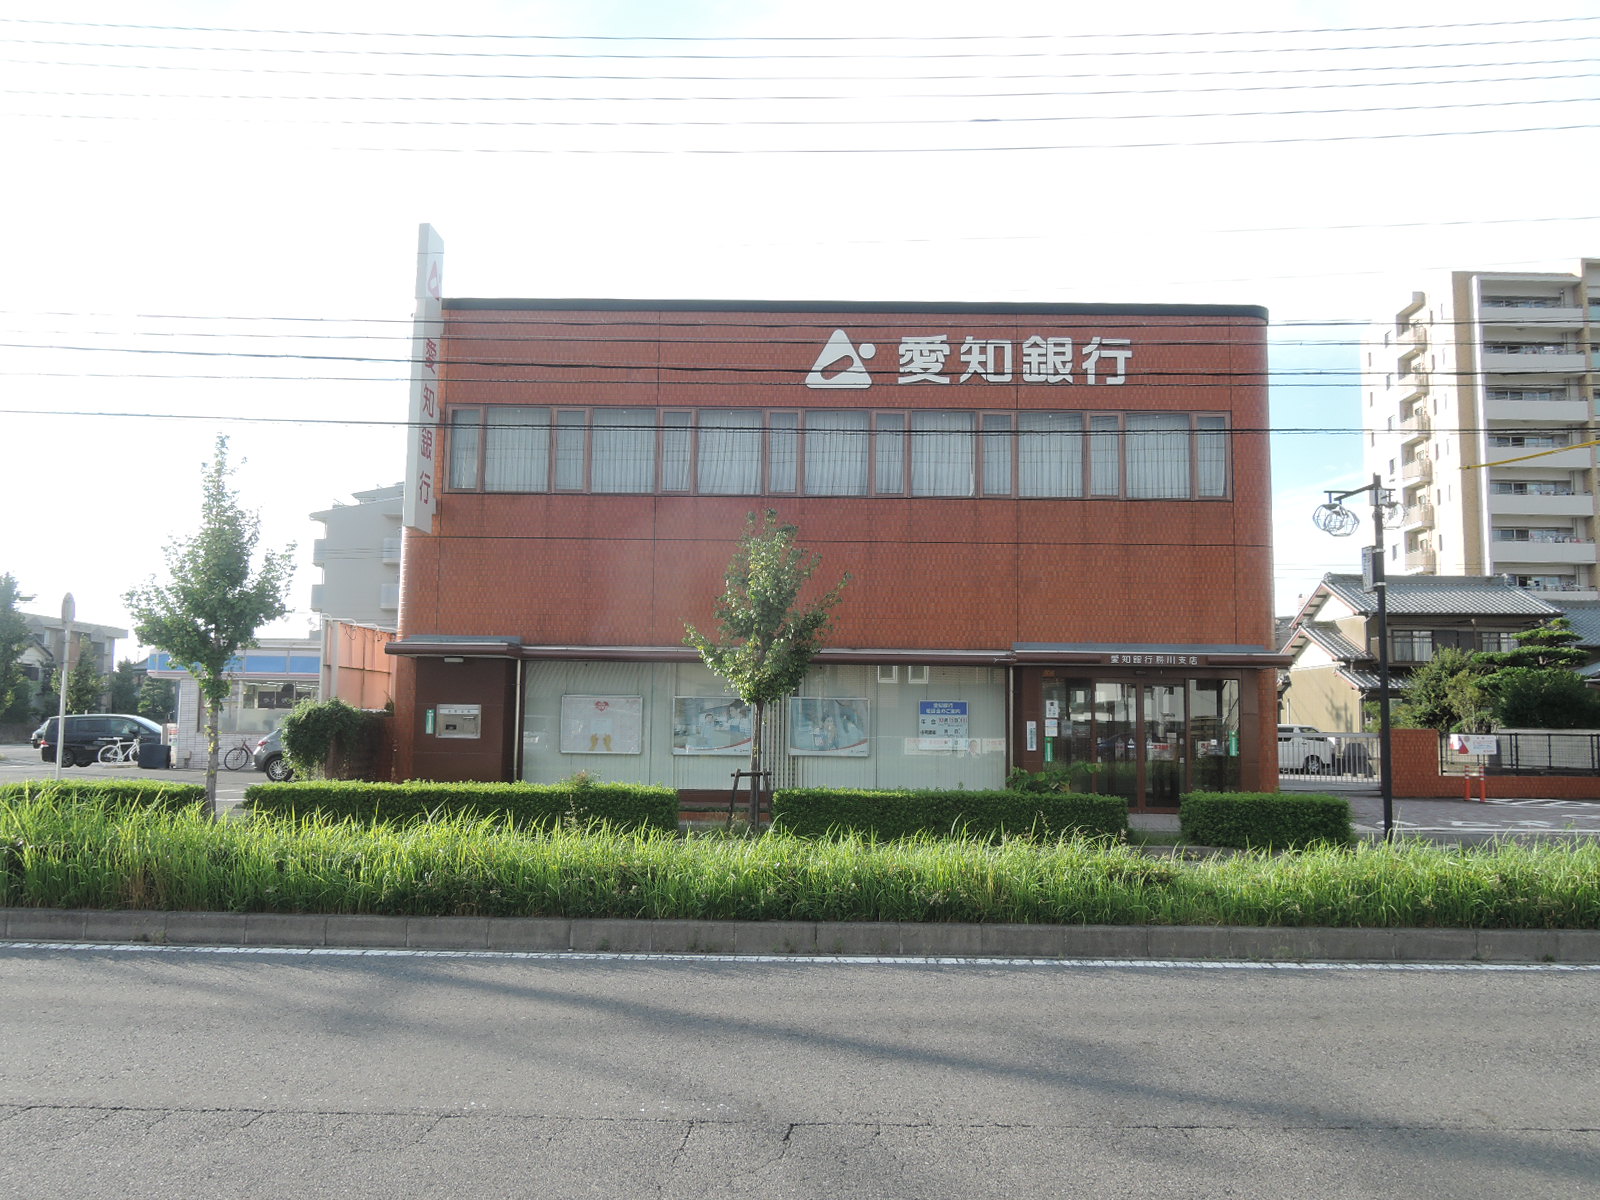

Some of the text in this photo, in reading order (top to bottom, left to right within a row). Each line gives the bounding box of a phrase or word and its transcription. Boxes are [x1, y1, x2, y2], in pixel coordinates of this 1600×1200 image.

[898, 334, 1133, 386] 愛知銀行
[419, 338, 437, 504] 愛知銀行
